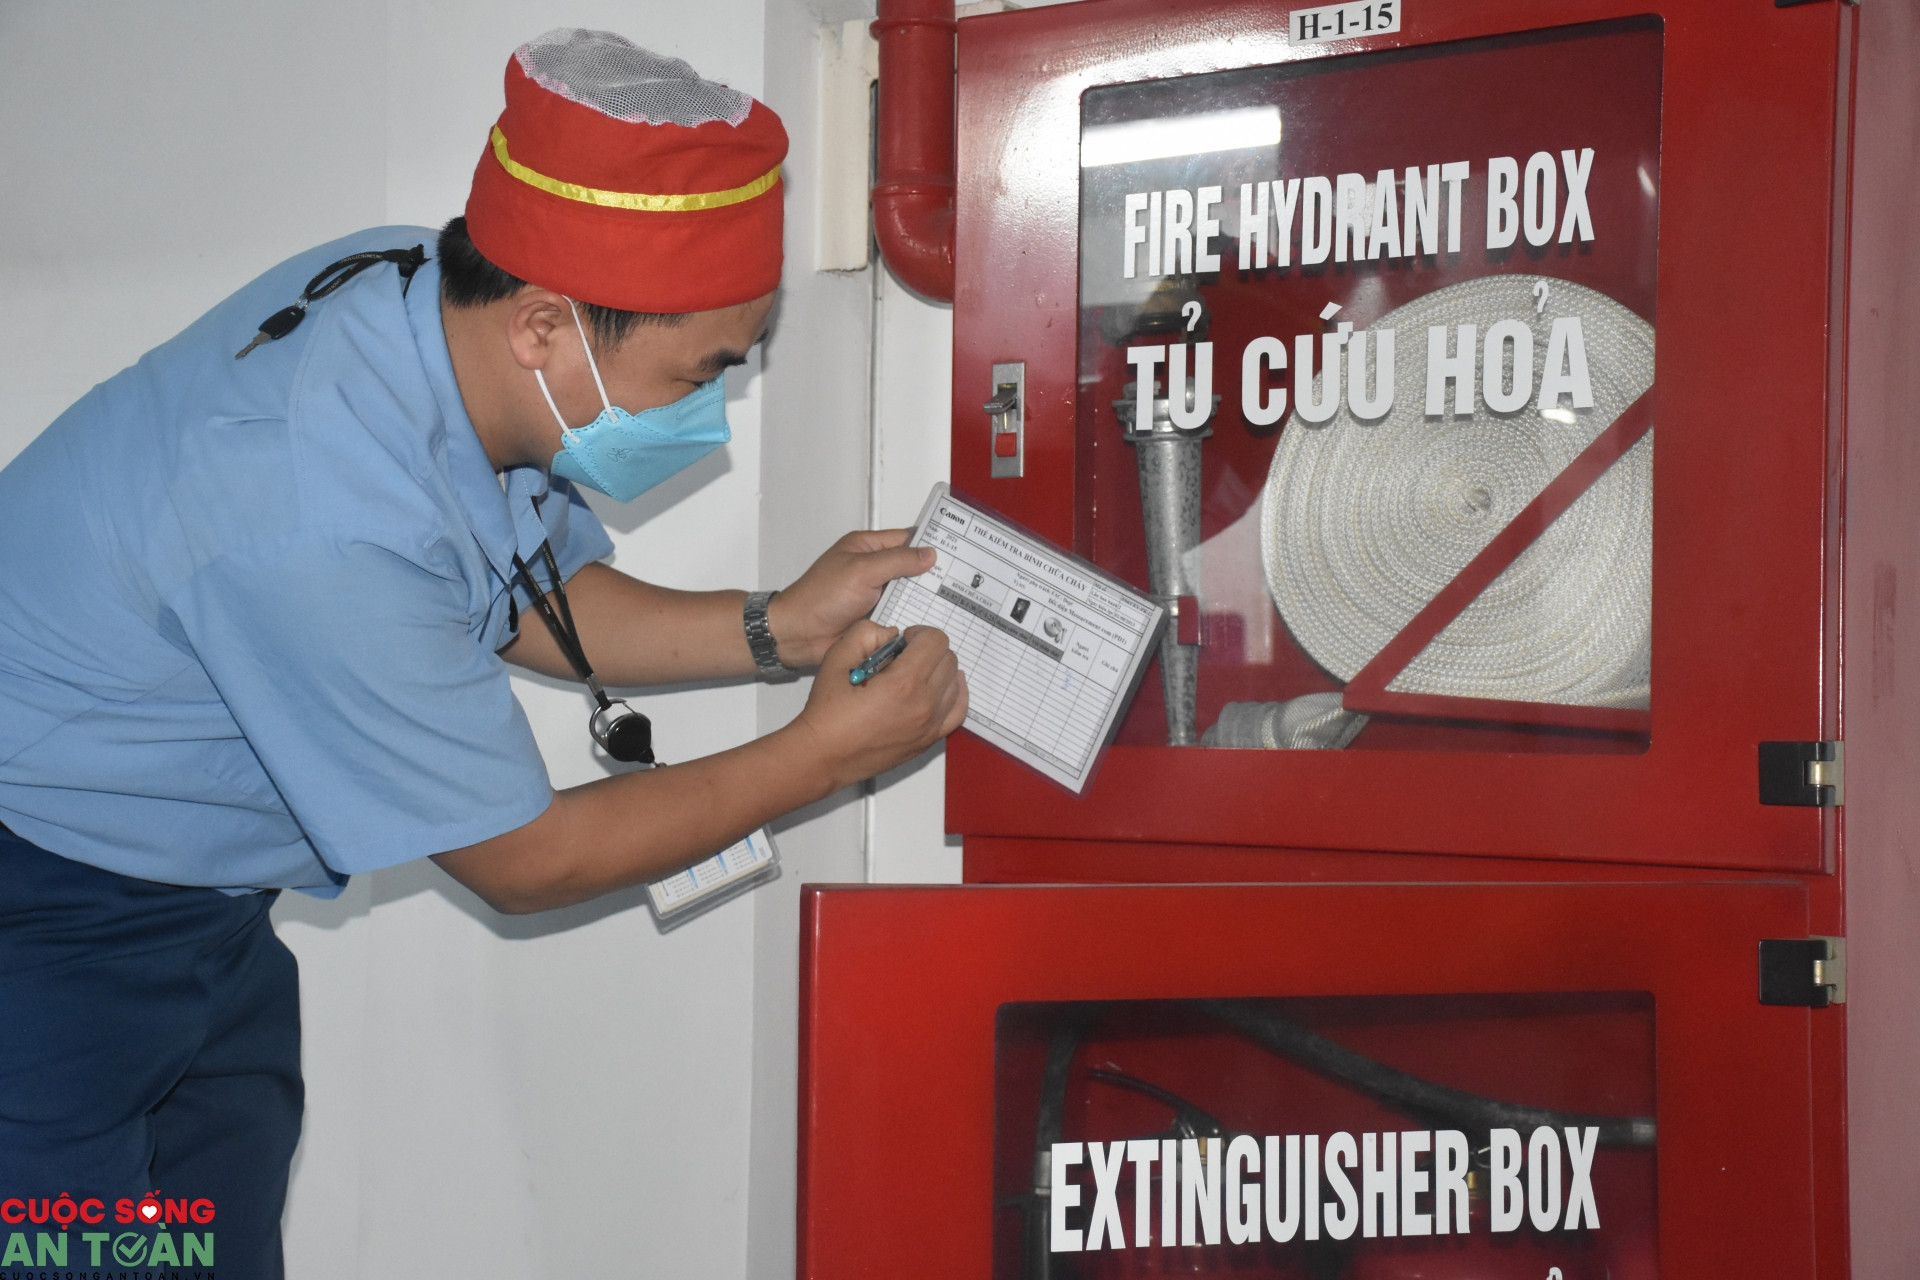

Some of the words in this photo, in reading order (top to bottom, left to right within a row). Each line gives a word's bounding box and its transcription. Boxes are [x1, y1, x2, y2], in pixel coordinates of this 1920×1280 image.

[1297, 2, 1393, 41] H-1-15
[1124, 186, 1222, 279] FIRE
[1238, 161, 1470, 270] HYDRANT
[1487, 148, 1595, 249] BOX
[1127, 301, 1213, 431] TỦ
[1242, 302, 1395, 426] CỨU
[1425, 281, 1594, 416] HOẢ
[938, 505, 966, 526] Canon
[945, 532, 958, 543] 2021
[972, 523, 990, 538] THẺ
[988, 532, 1009, 549] KIỂM
[1008, 544, 1024, 557] TRA
[1022, 551, 1043, 568] BÌNH
[1042, 562, 1066, 580] CHỮA
[1064, 574, 1087, 591] CHÁY
[1050, 1129, 1470, 1253] EXTINGUISHER
[1490, 1126, 1600, 1233] BOX
